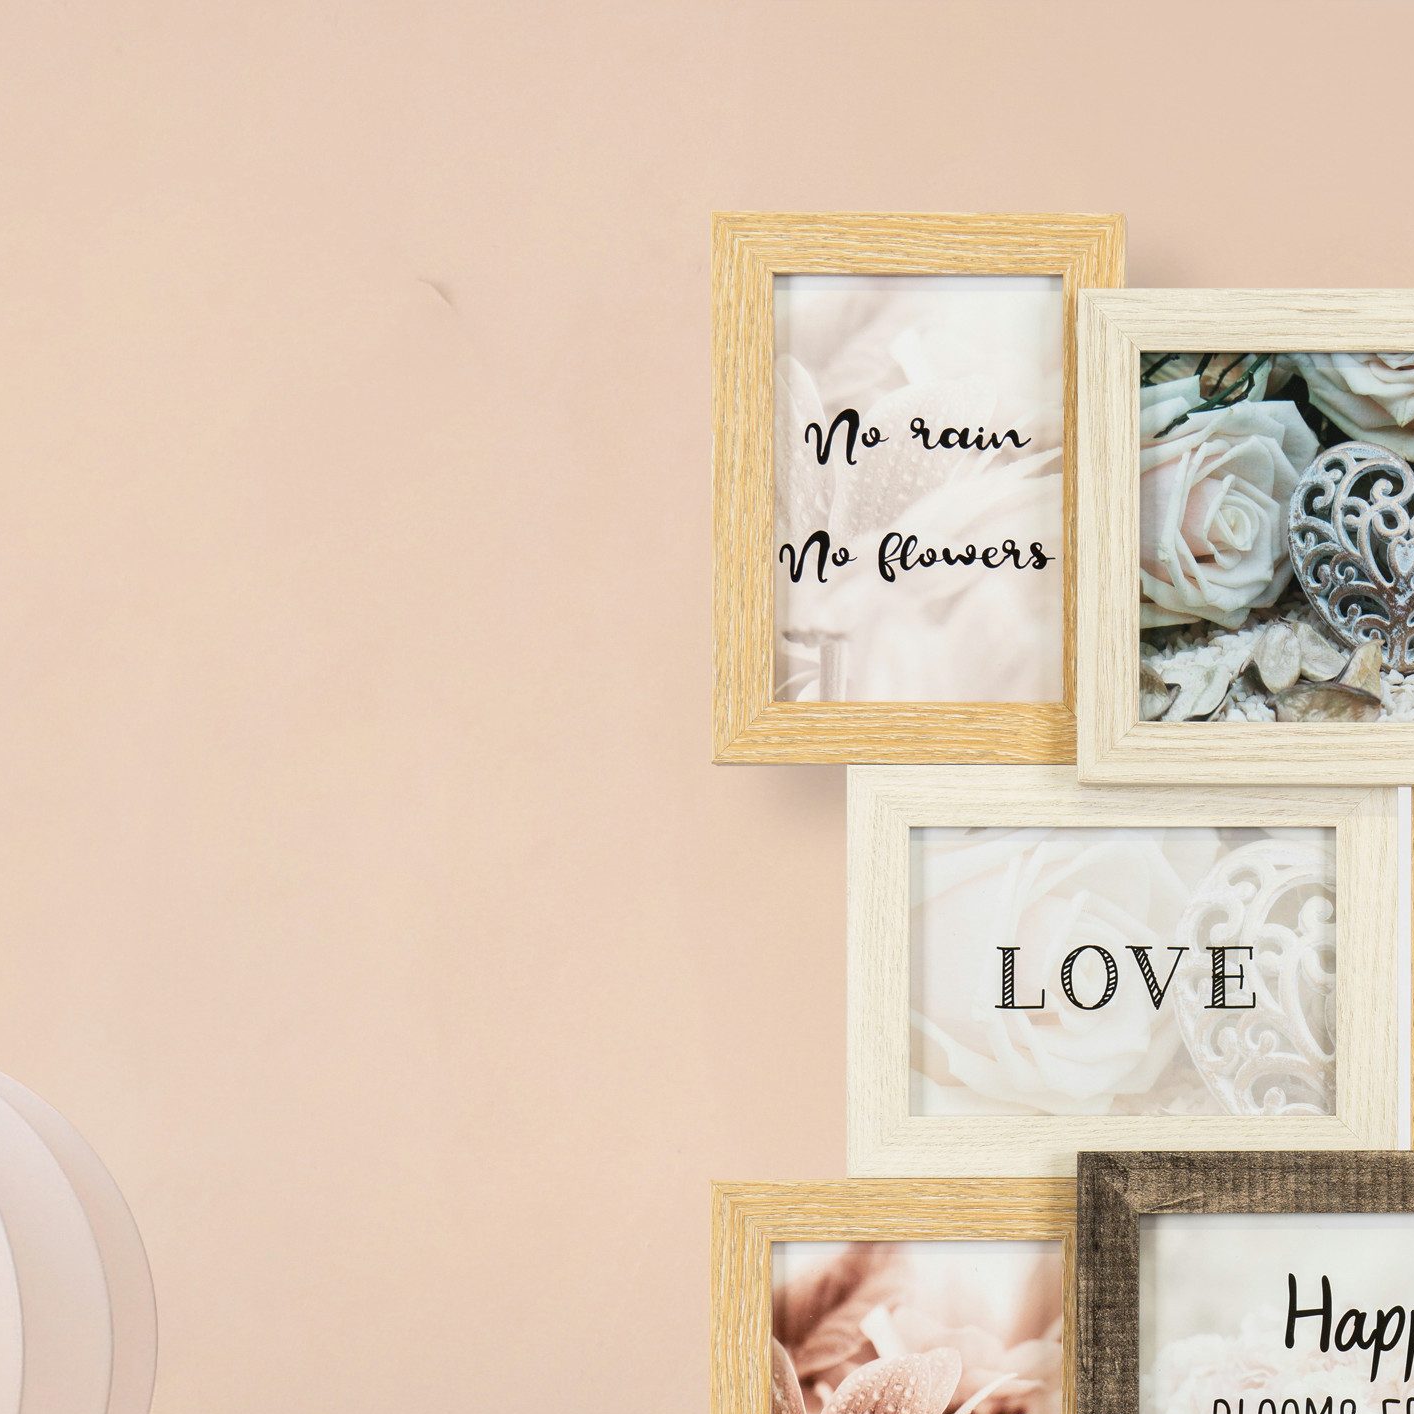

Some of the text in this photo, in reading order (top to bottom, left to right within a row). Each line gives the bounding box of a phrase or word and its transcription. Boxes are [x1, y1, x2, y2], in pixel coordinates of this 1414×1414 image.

[804, 408, 1033, 466] No rain
[777, 529, 1057, 585] No flowers
[993, 944, 1257, 1012] LOVE
